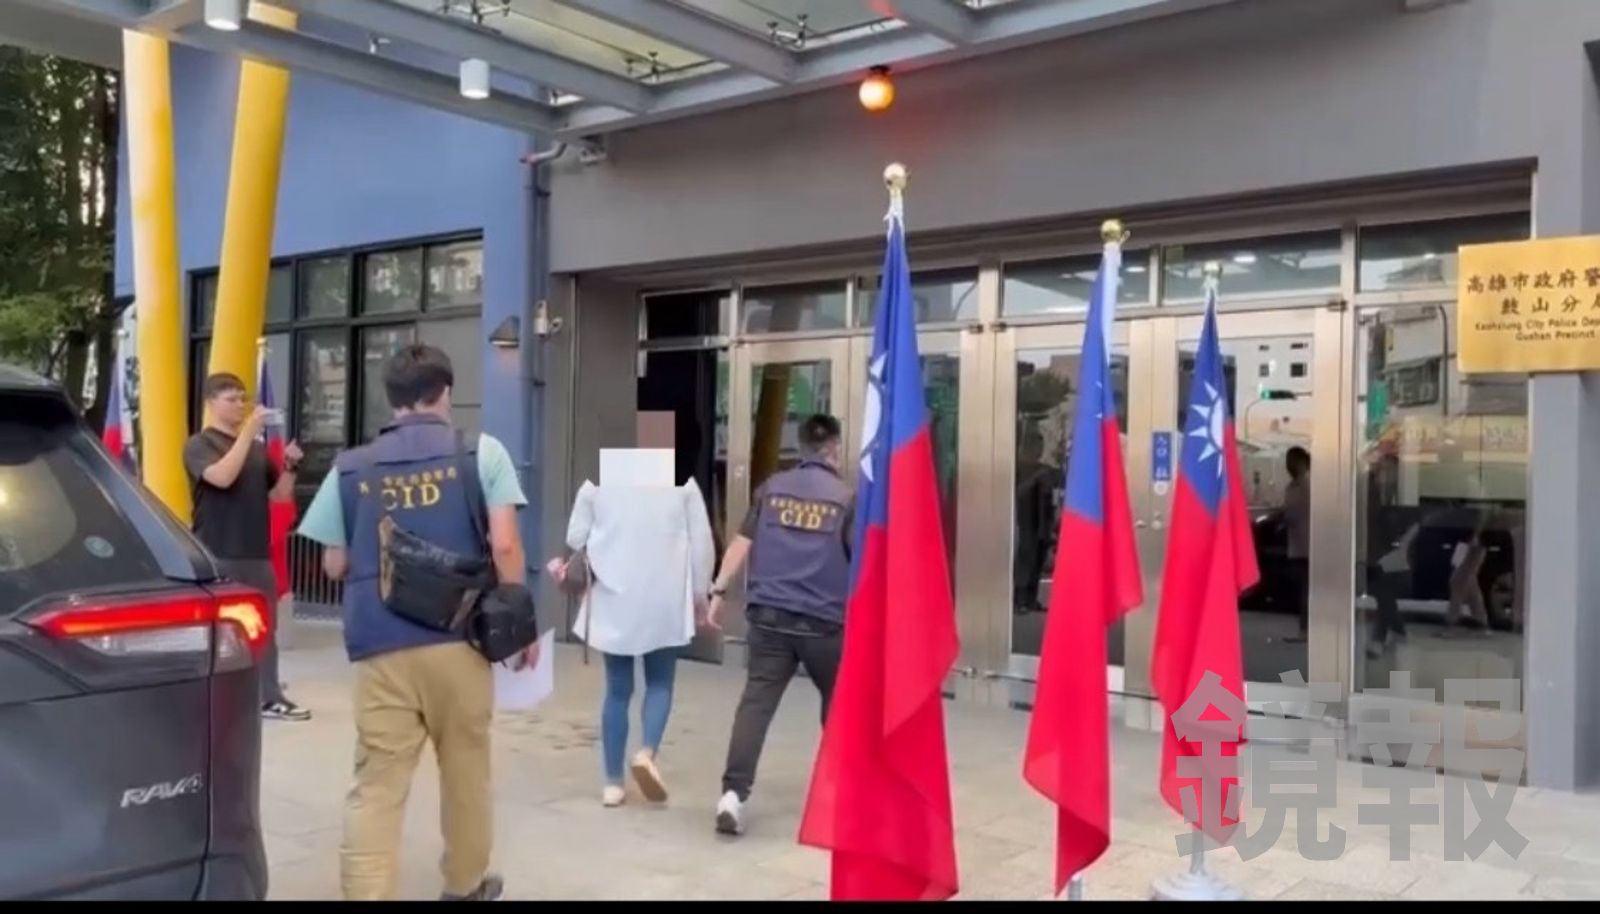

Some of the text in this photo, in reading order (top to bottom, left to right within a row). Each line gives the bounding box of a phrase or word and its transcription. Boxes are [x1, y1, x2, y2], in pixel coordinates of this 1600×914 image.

[1526, 319, 1545, 331] City
[1548, 317, 1577, 328] Police
[1515, 329, 1596, 341] Gushan Precinct
[381, 483, 441, 511] CID
[781, 509, 822, 530] CID
[120, 772, 203, 808] RAV4
